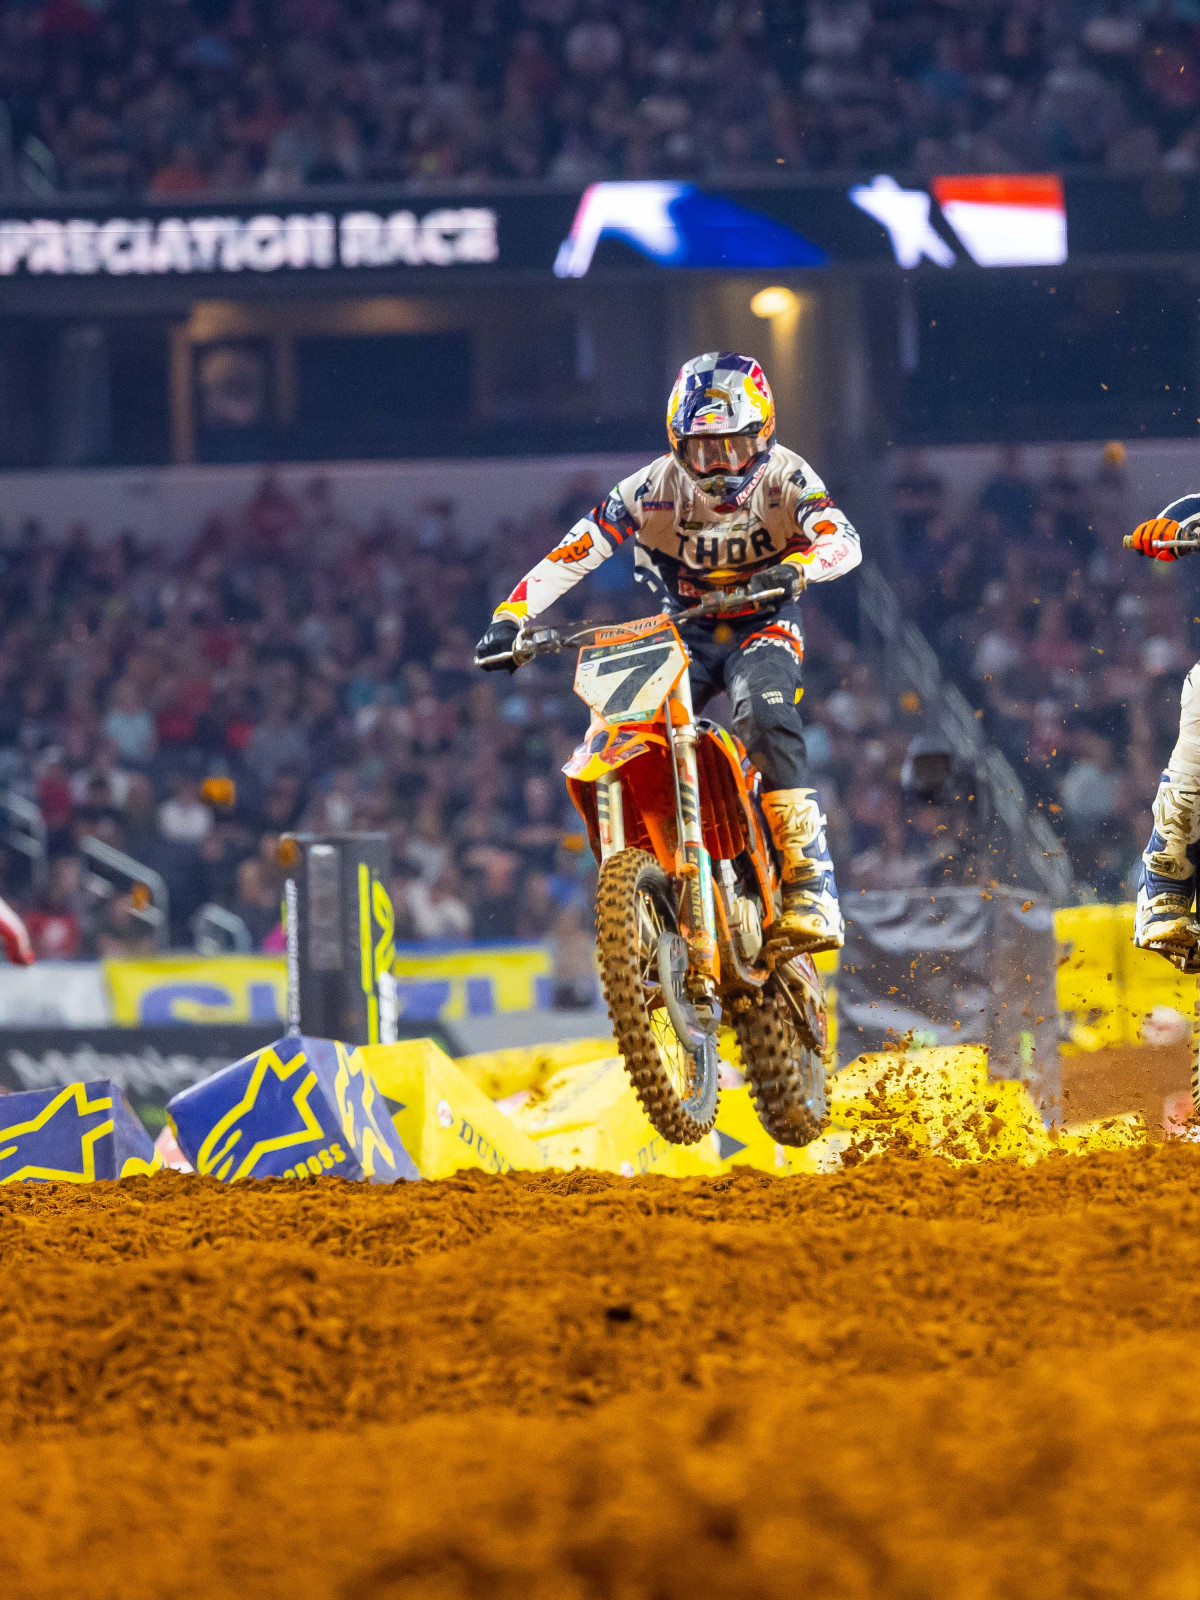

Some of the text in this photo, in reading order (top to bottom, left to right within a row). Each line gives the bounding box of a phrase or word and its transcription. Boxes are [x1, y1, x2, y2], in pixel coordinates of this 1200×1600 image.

[341, 208, 499, 268] RACE
[676, 527, 778, 566] THOR
[596, 645, 672, 718] 7
[687, 852, 700, 919] DUNP
